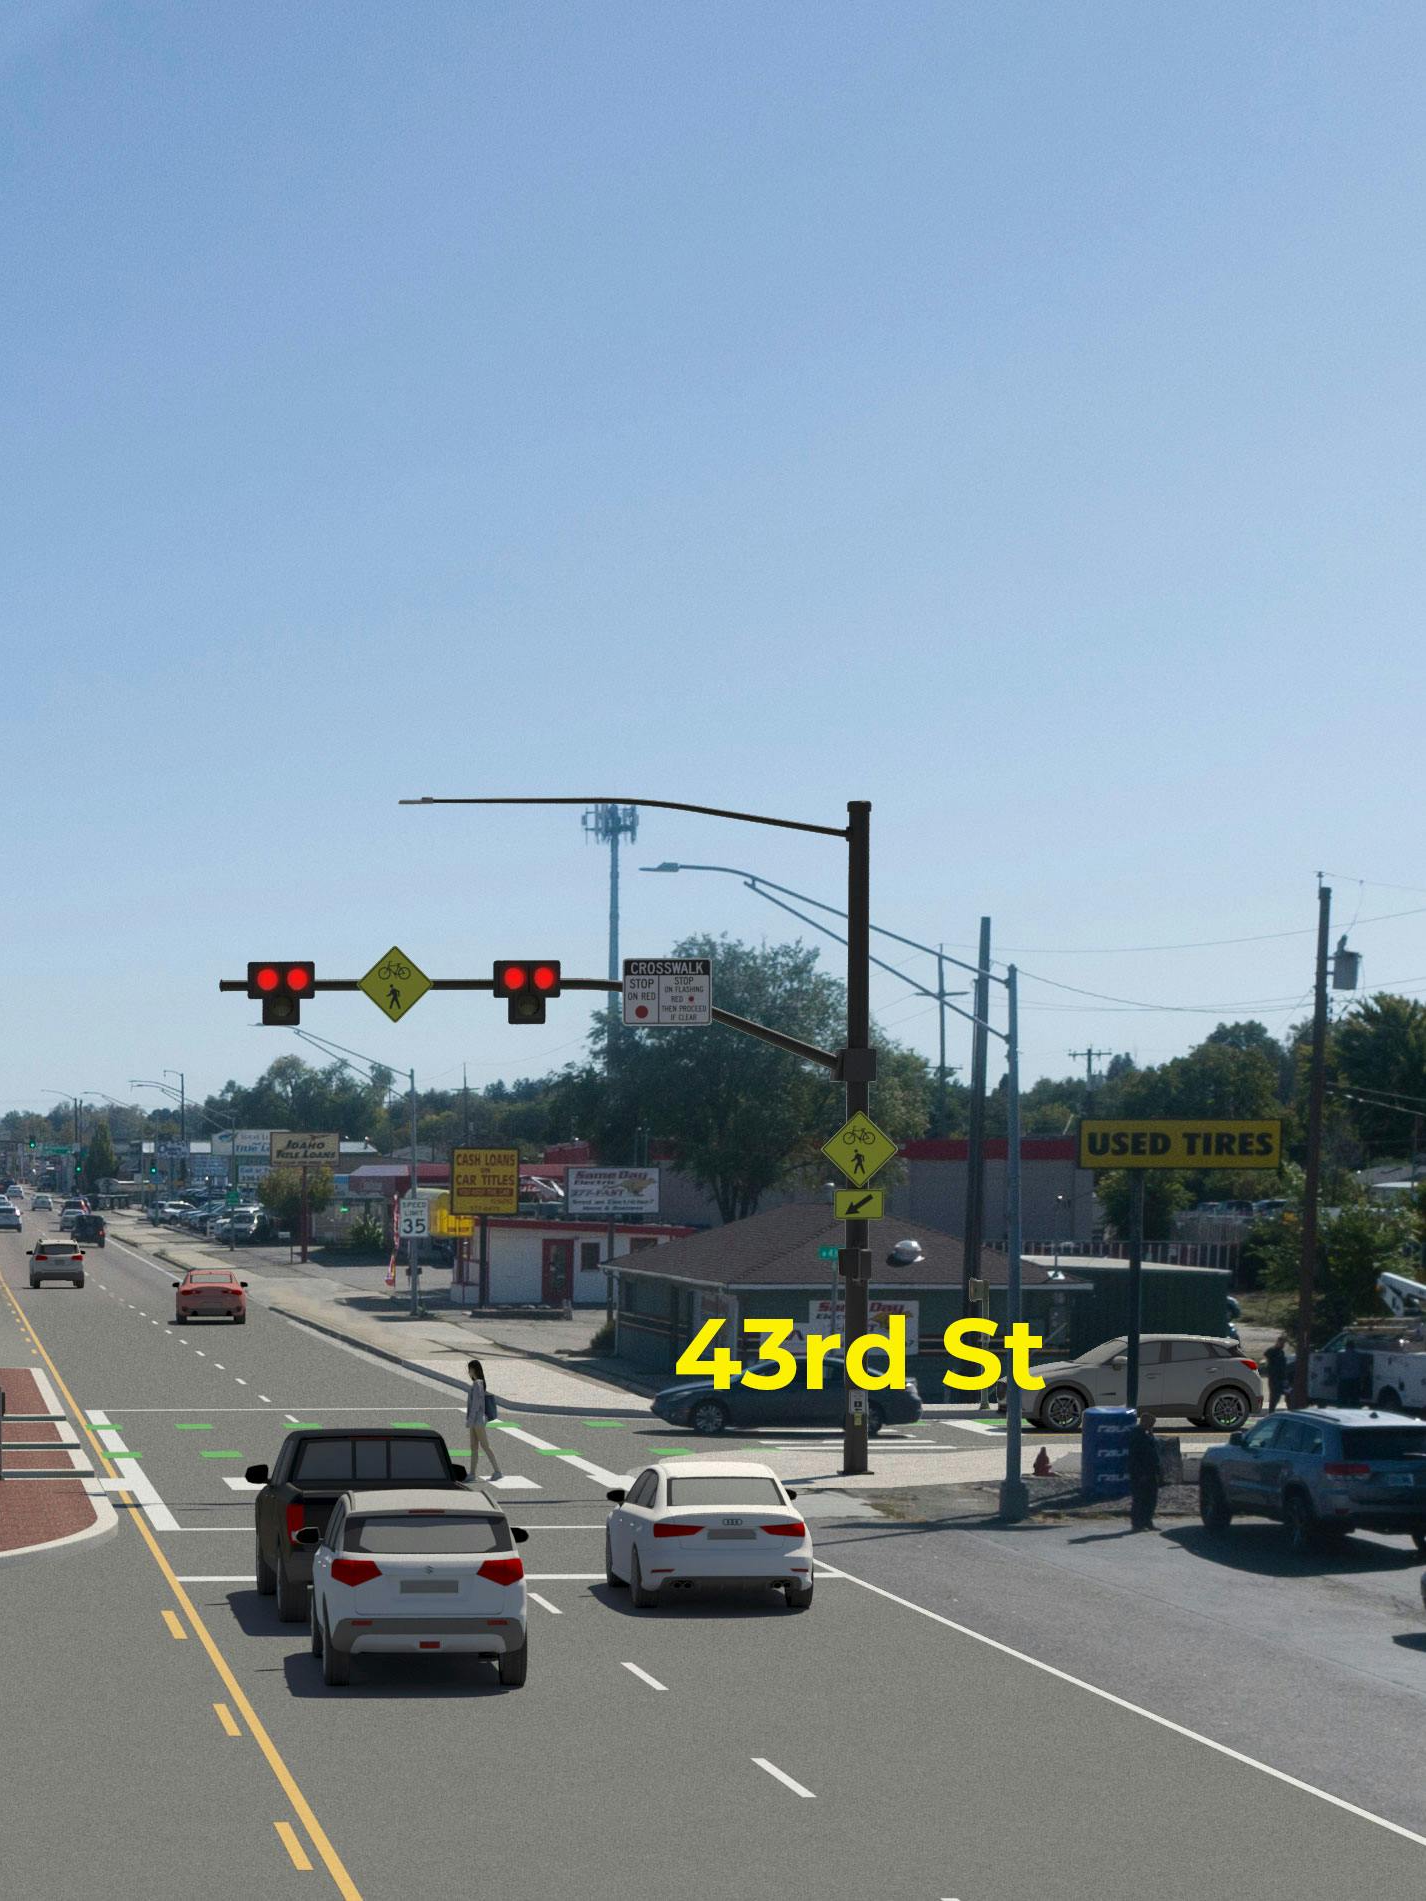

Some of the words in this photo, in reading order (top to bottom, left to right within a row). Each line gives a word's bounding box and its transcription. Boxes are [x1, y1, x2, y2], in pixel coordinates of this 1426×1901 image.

[630, 961, 704, 975] CROSSWALK
[629, 978, 654, 989] STOP
[674, 976, 694, 986] STOP
[627, 992, 638, 1001] ON
[641, 992, 656, 1001] RED
[662, 1005, 677, 1013] THEN
[679, 1005, 707, 1013] PROCEED
[286, 1139, 325, 1149] IDAHO
[1087, 1132, 1172, 1156] USED
[1182, 1132, 1273, 1156] TIRES
[456, 1154, 481, 1166] CASH
[485, 1154, 515, 1166] LOANS
[455, 1174, 477, 1186] CAR
[482, 1174, 515, 1186] TITLES
[575, 1170, 616, 1179] Same
[618, 1170, 648, 1180] Day
[403, 1218, 426, 1234] 35
